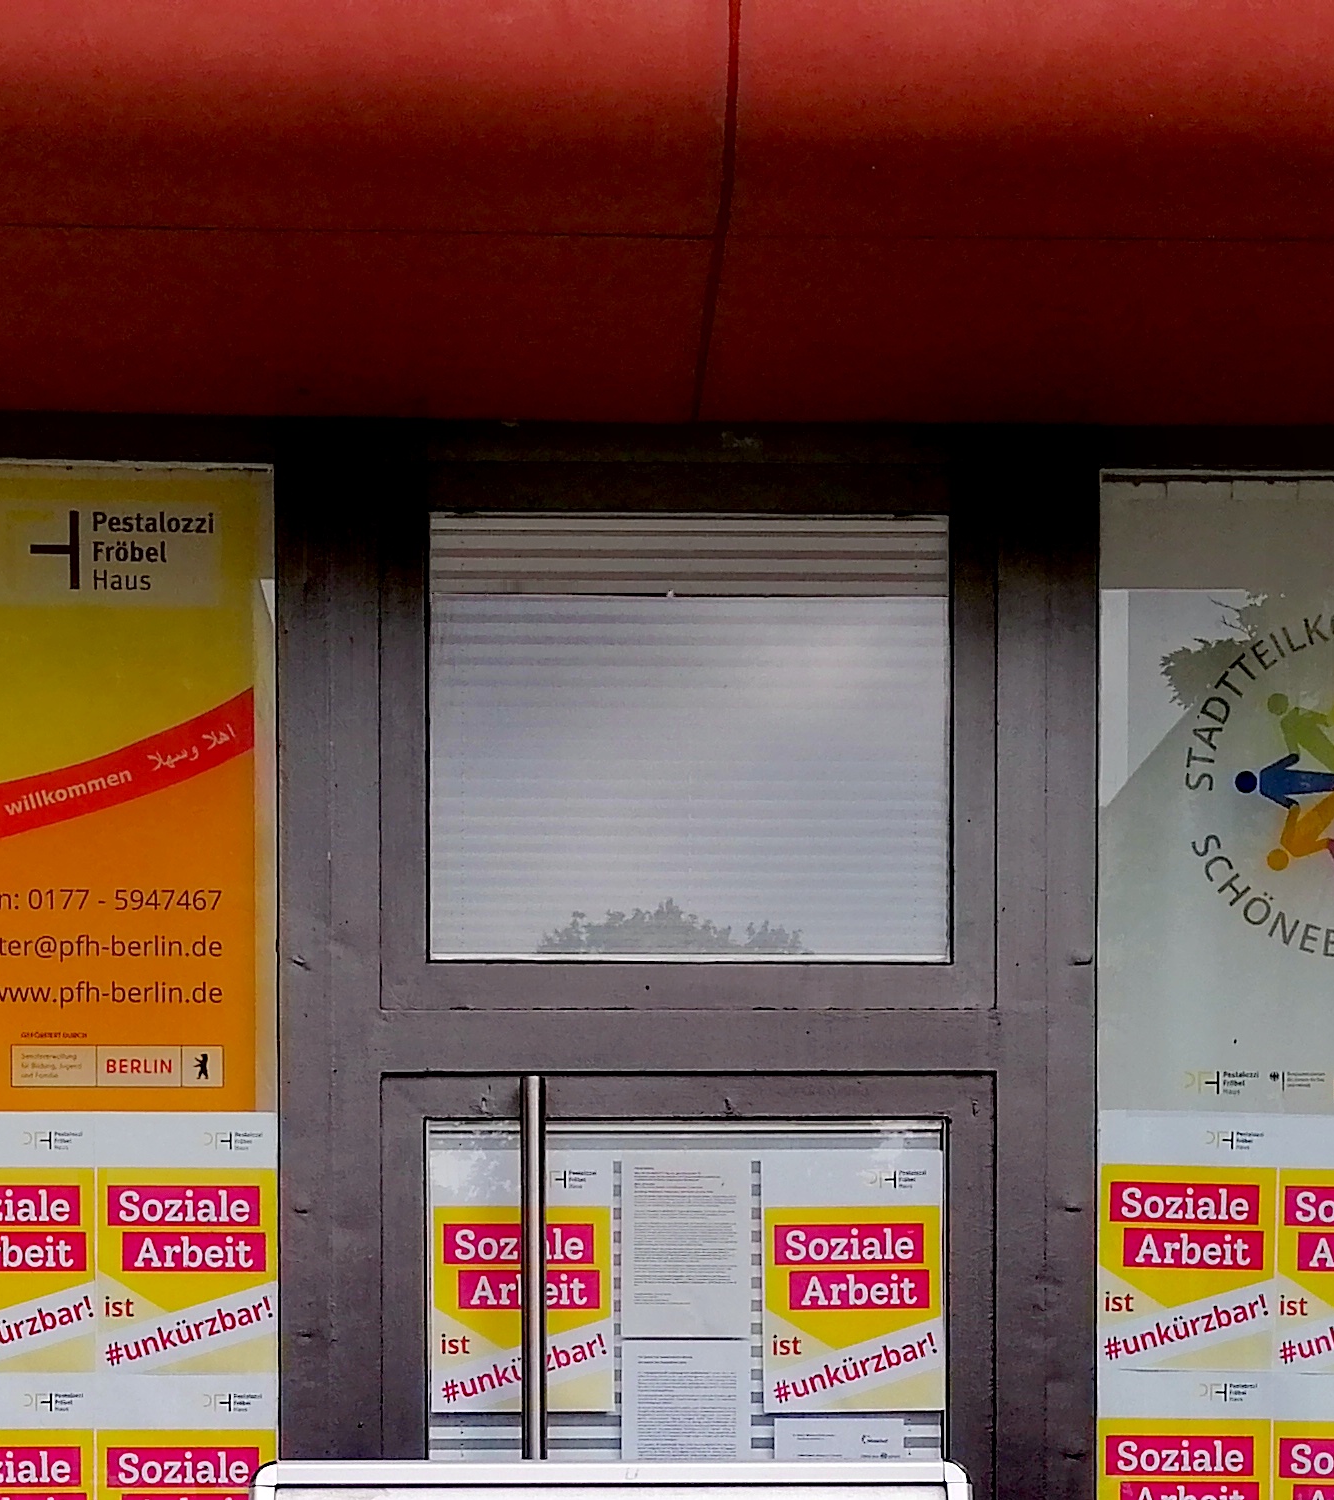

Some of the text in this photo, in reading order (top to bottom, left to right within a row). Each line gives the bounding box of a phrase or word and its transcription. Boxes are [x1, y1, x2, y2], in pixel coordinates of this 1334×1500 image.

[93, 510, 215, 534] Pestalozzi
[93, 540, 168, 563] Fröbel
[93, 569, 151, 591] Haus
[4, 768, 133, 817] willkommen
[27, 888, 89, 911] 0177
[114, 888, 222, 912] 5947467
[106, 1058, 173, 1074] BERLIN
[119, 1189, 250, 1223] Soziale
[1121, 1187, 1249, 1221] Soziale
[134, 1235, 254, 1268] Arbeit
[454, 1227, 585, 1261] Sozle
[785, 1227, 914, 1261] Soziale
[1135, 1233, 1251, 1266] Arbeit
[469, 1273, 588, 1306] Areit
[801, 1273, 918, 1306] Arbeit
[1105, 1290, 1135, 1313] ist
[1279, 1294, 1309, 1317] ist
[105, 1295, 135, 1318] ist
[105, 1295, 274, 1367] #unkürzbar!
[1103, 1293, 1269, 1361] #unkürzbar!
[441, 1333, 471, 1355] ist
[772, 1334, 802, 1356] ist
[773, 1331, 938, 1403] #unkürzbar!
[118, 1451, 250, 1485] Soziale
[1117, 1440, 1244, 1472] Soziale
